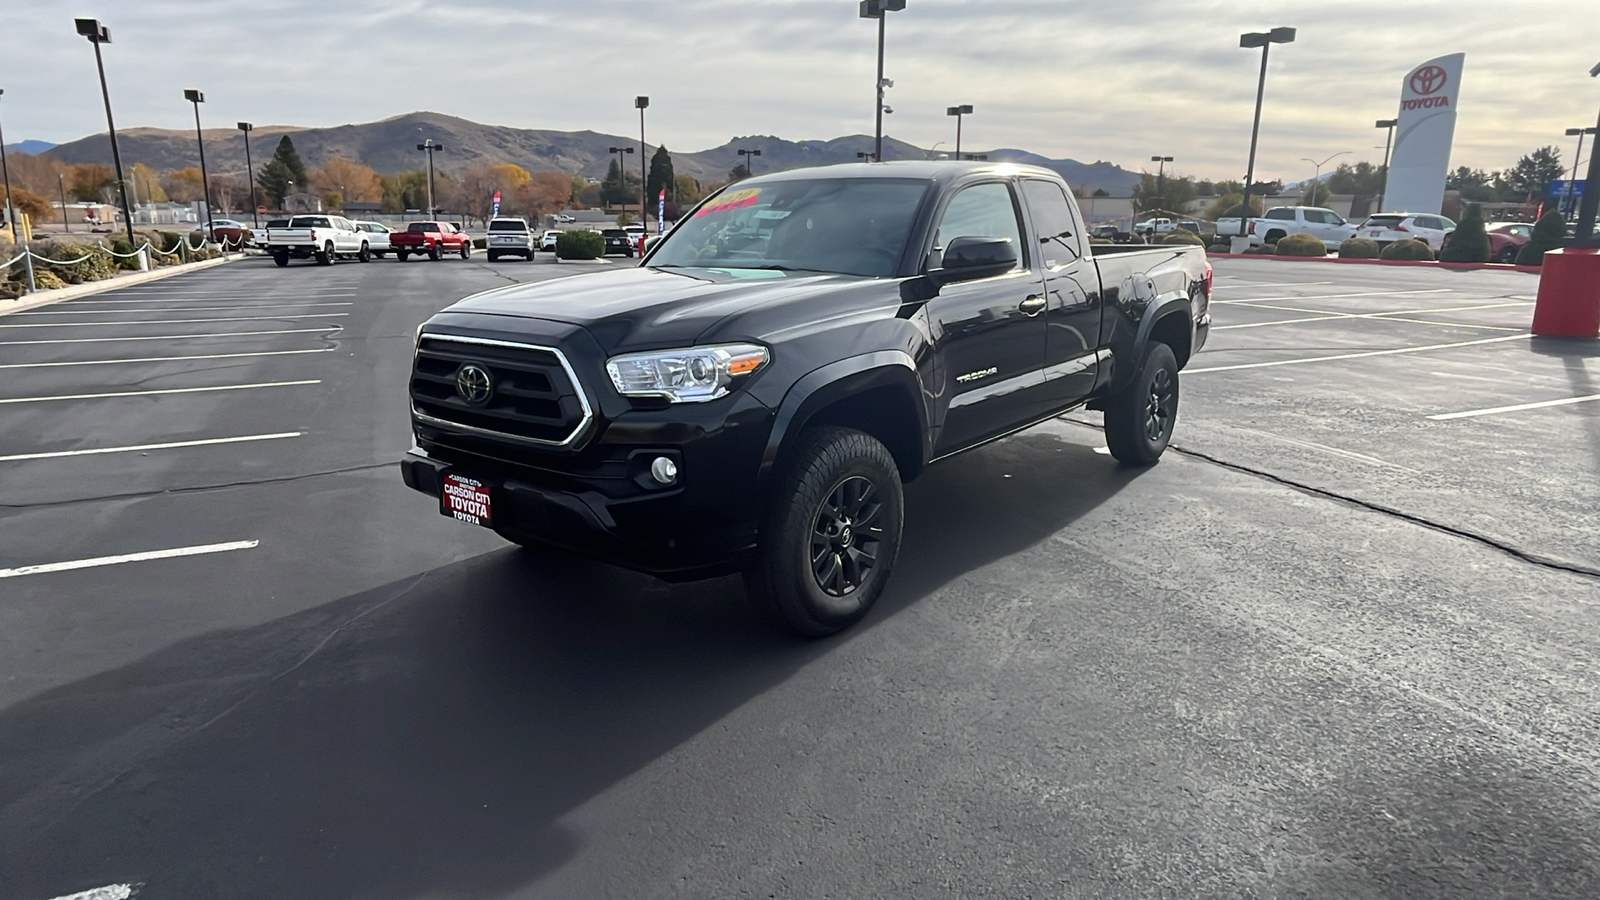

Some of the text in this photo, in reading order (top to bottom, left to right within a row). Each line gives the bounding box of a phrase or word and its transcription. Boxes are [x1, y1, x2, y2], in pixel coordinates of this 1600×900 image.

[1402, 96, 1449, 111] TOYOTA
[956, 366, 998, 384] TACOMA
[451, 474, 480, 487] CARSON CITY
[444, 484, 474, 500] CARSON
[449, 495, 488, 518] TOYOTA
[453, 511, 480, 525] TOYOTA
